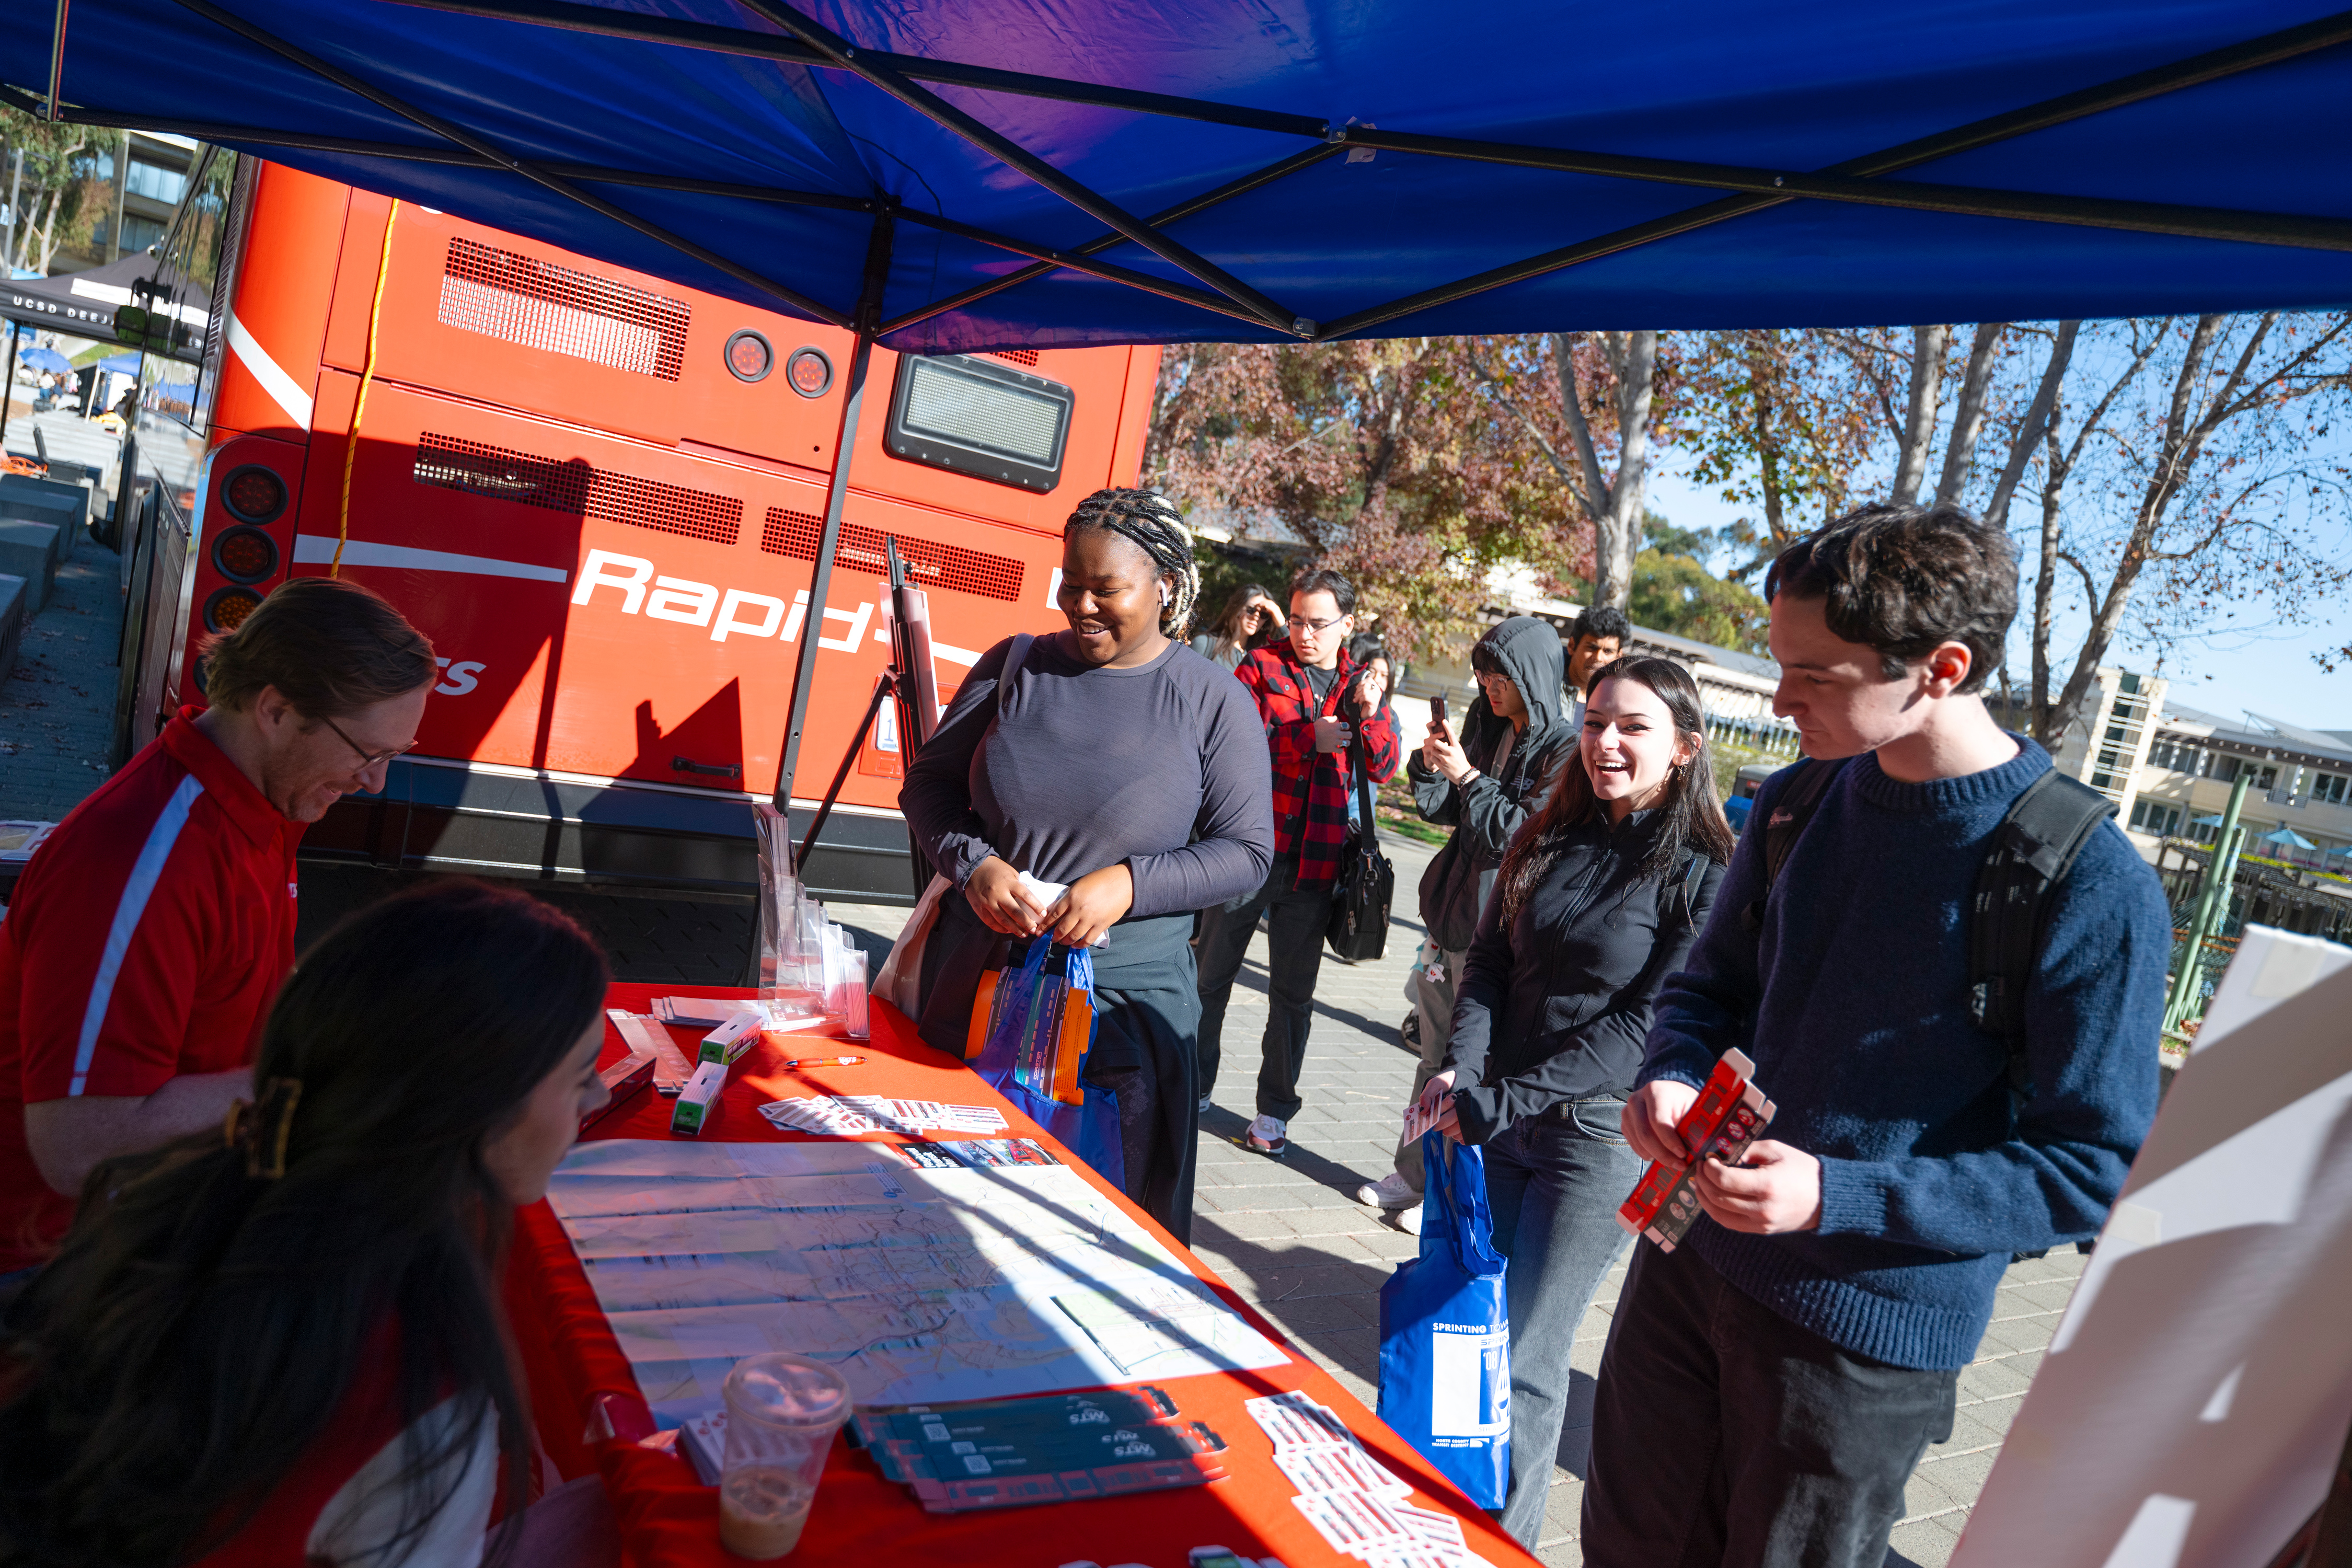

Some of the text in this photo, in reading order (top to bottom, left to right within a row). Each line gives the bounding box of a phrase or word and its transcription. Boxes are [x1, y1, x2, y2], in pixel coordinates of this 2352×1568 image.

[13, 295, 57, 314] UCSD
[571, 548, 874, 653] Rapid
[905, 1147, 936, 1168] Regional
[923, 1151, 947, 1168] Transit
[942, 1156, 960, 1168] Map
[1433, 1322, 1486, 1333] SPRINTING
[1114, 1444, 1149, 1458] MTS
